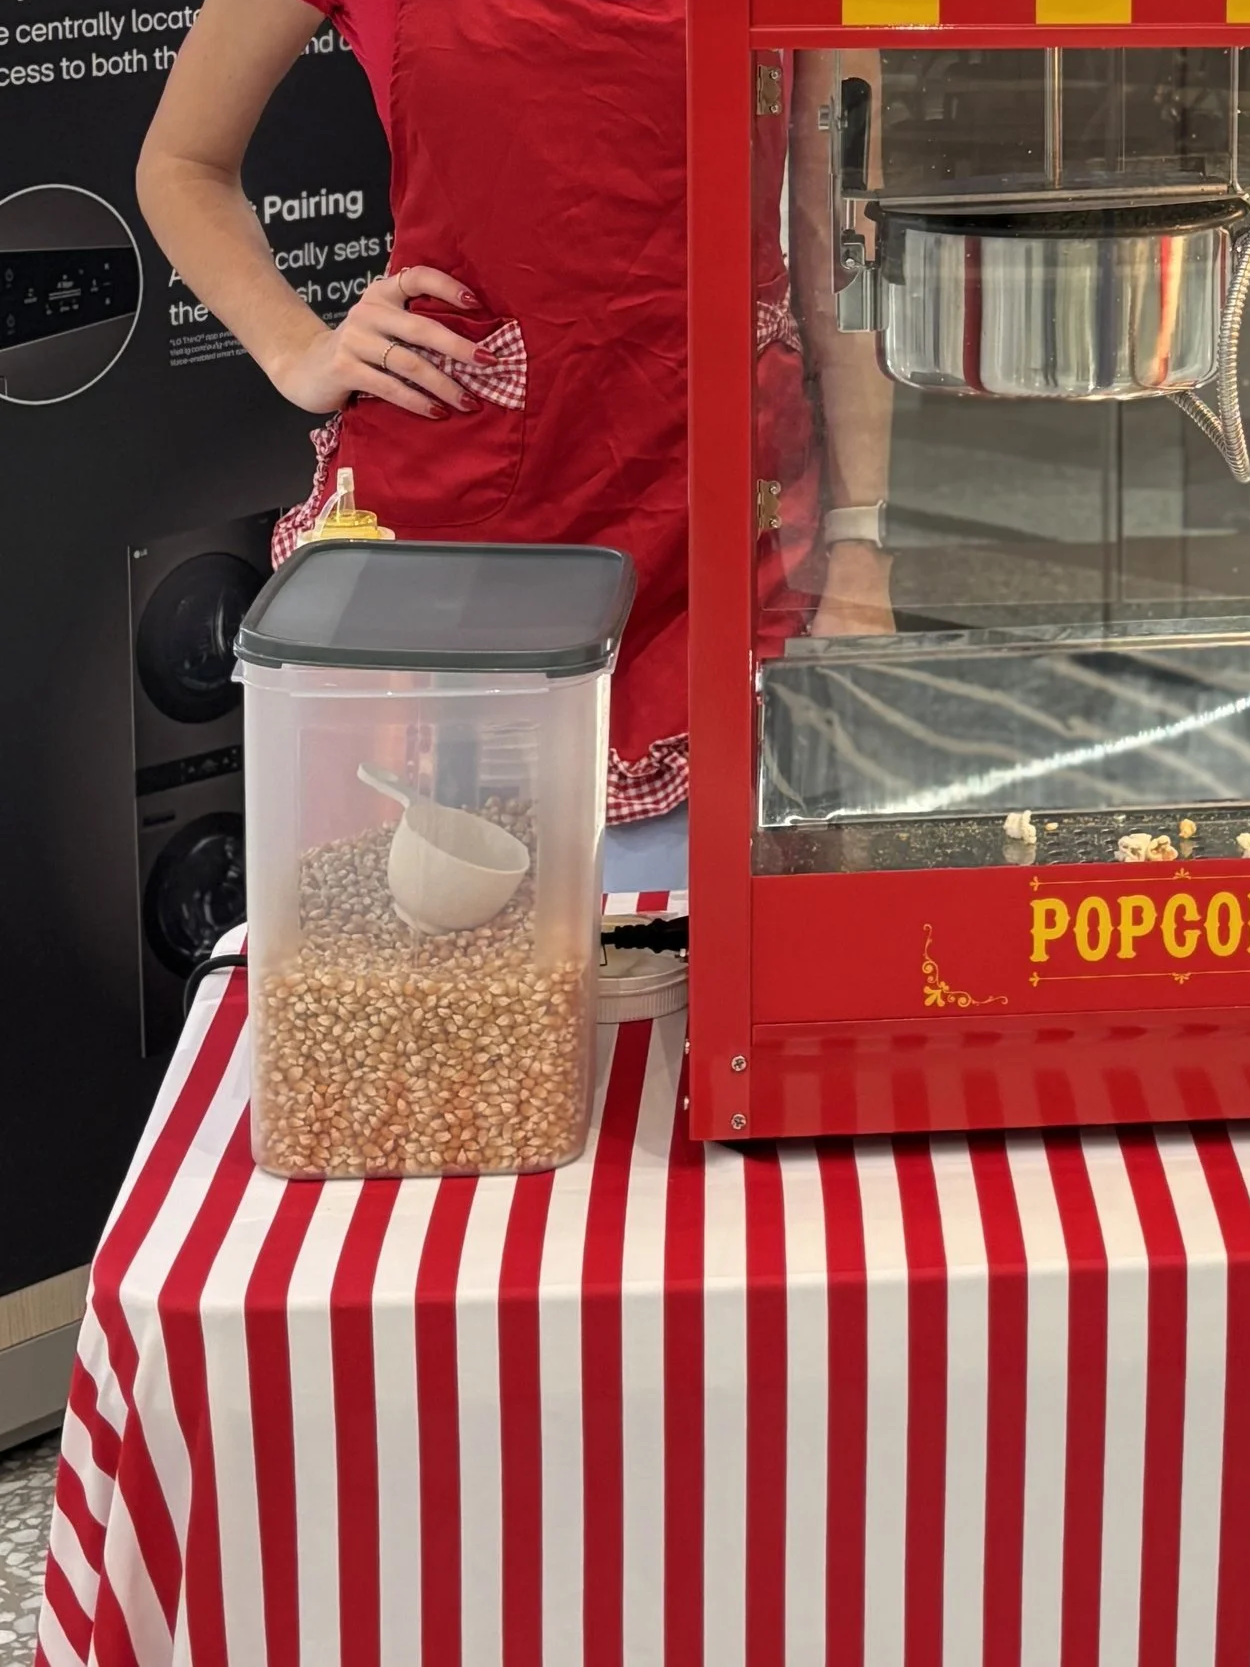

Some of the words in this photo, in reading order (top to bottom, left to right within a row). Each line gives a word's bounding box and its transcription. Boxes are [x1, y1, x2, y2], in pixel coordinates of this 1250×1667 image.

[15, 11, 126, 43] centrally
[60, 57, 86, 80] to
[92, 45, 148, 77] both
[264, 188, 363, 224] Pairing
[270, 241, 329, 271] cally
[333, 235, 381, 261] sets
[169, 301, 209, 325] the
